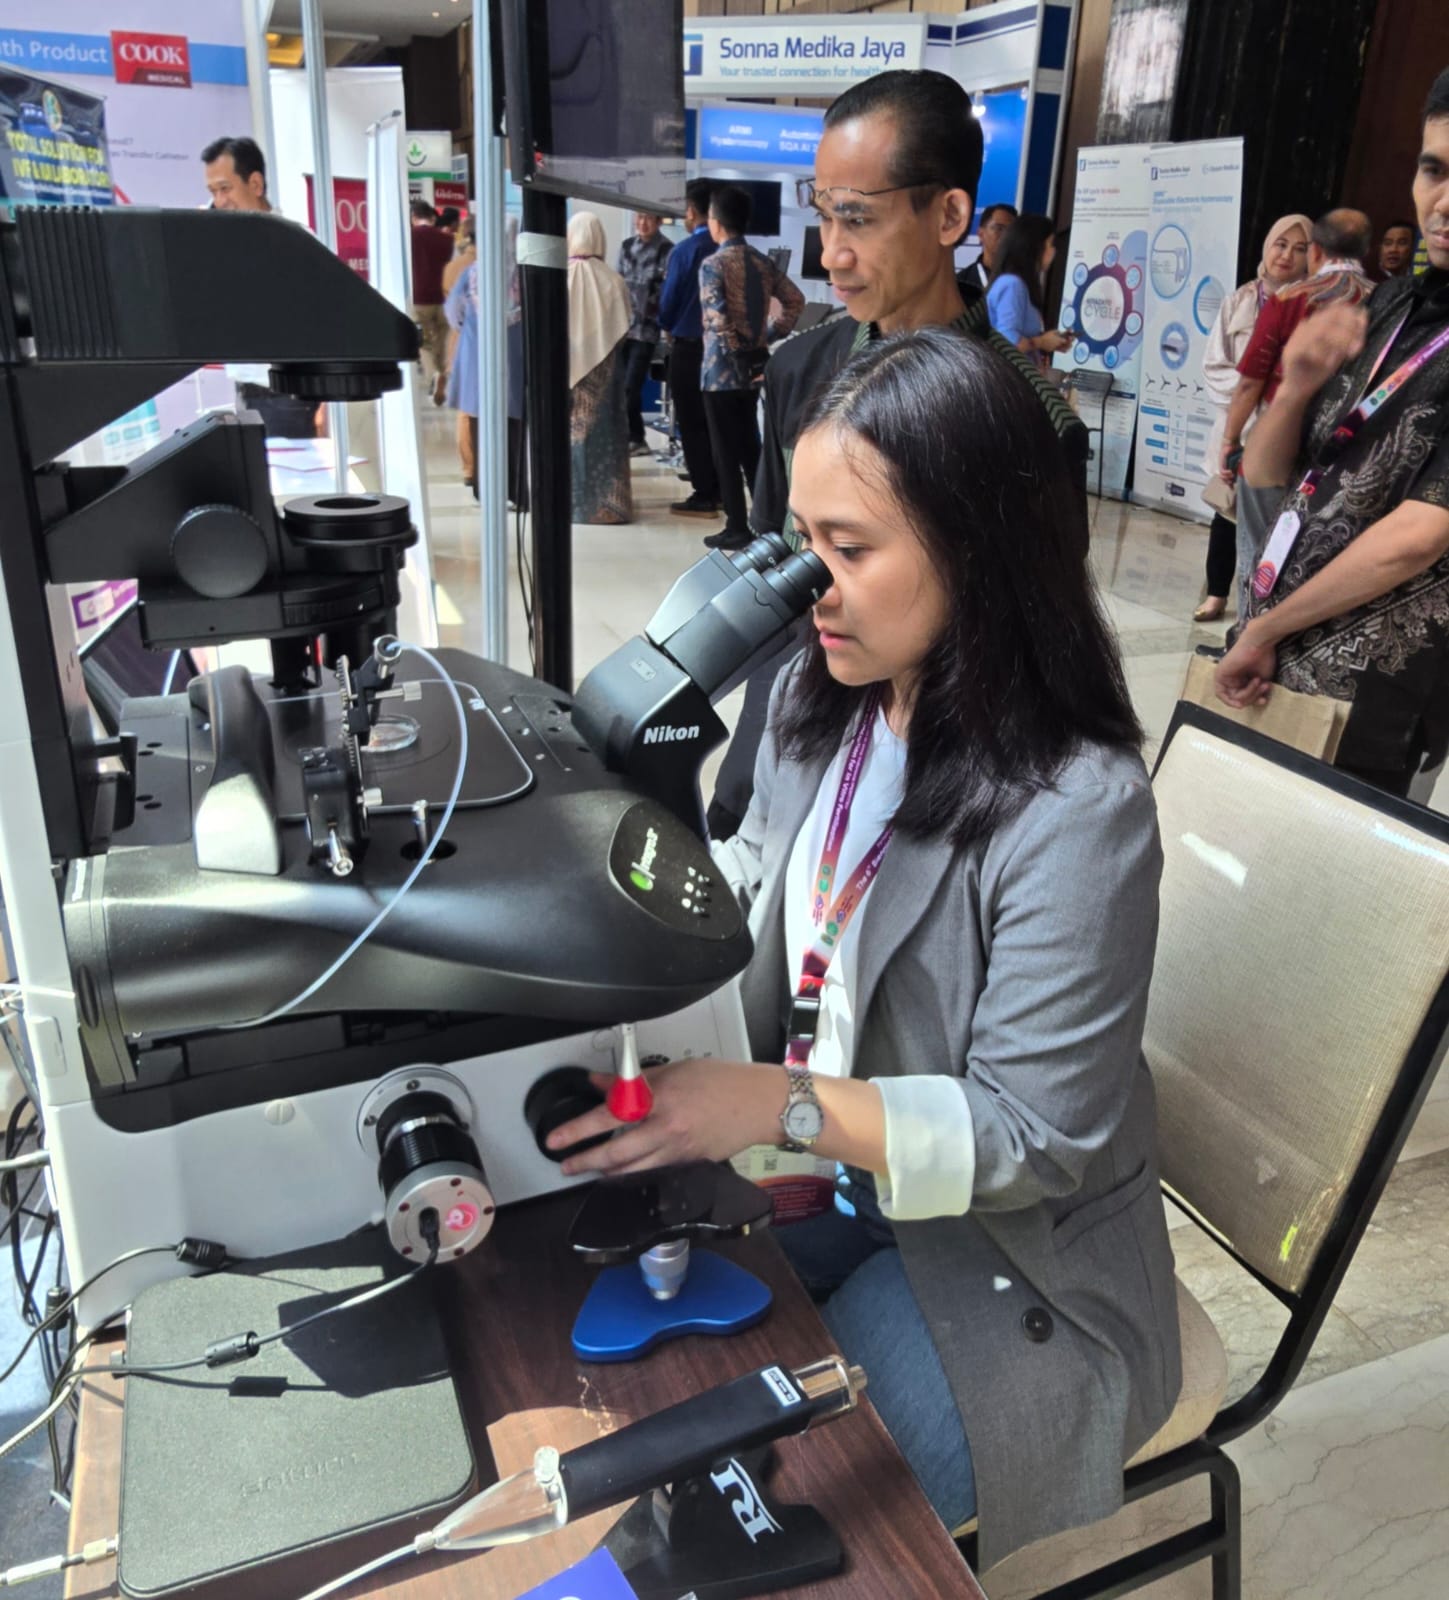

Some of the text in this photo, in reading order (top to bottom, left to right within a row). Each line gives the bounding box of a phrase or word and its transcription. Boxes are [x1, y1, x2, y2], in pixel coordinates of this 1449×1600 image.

[0, 41, 108, 63] th Product
[119, 42, 184, 65] COOK
[720, 35, 905, 65] Sonna Medika Jaya
[147, 74, 186, 84] MEDICAL
[720, 66, 740, 77] Your
[743, 67, 777, 77] trusted
[779, 67, 832, 77] connection
[833, 66, 847, 77] for
[643, 725, 700, 744] Nikon
[838, 782, 849, 803] Vitro
[709, 1463, 775, 1543] RI
